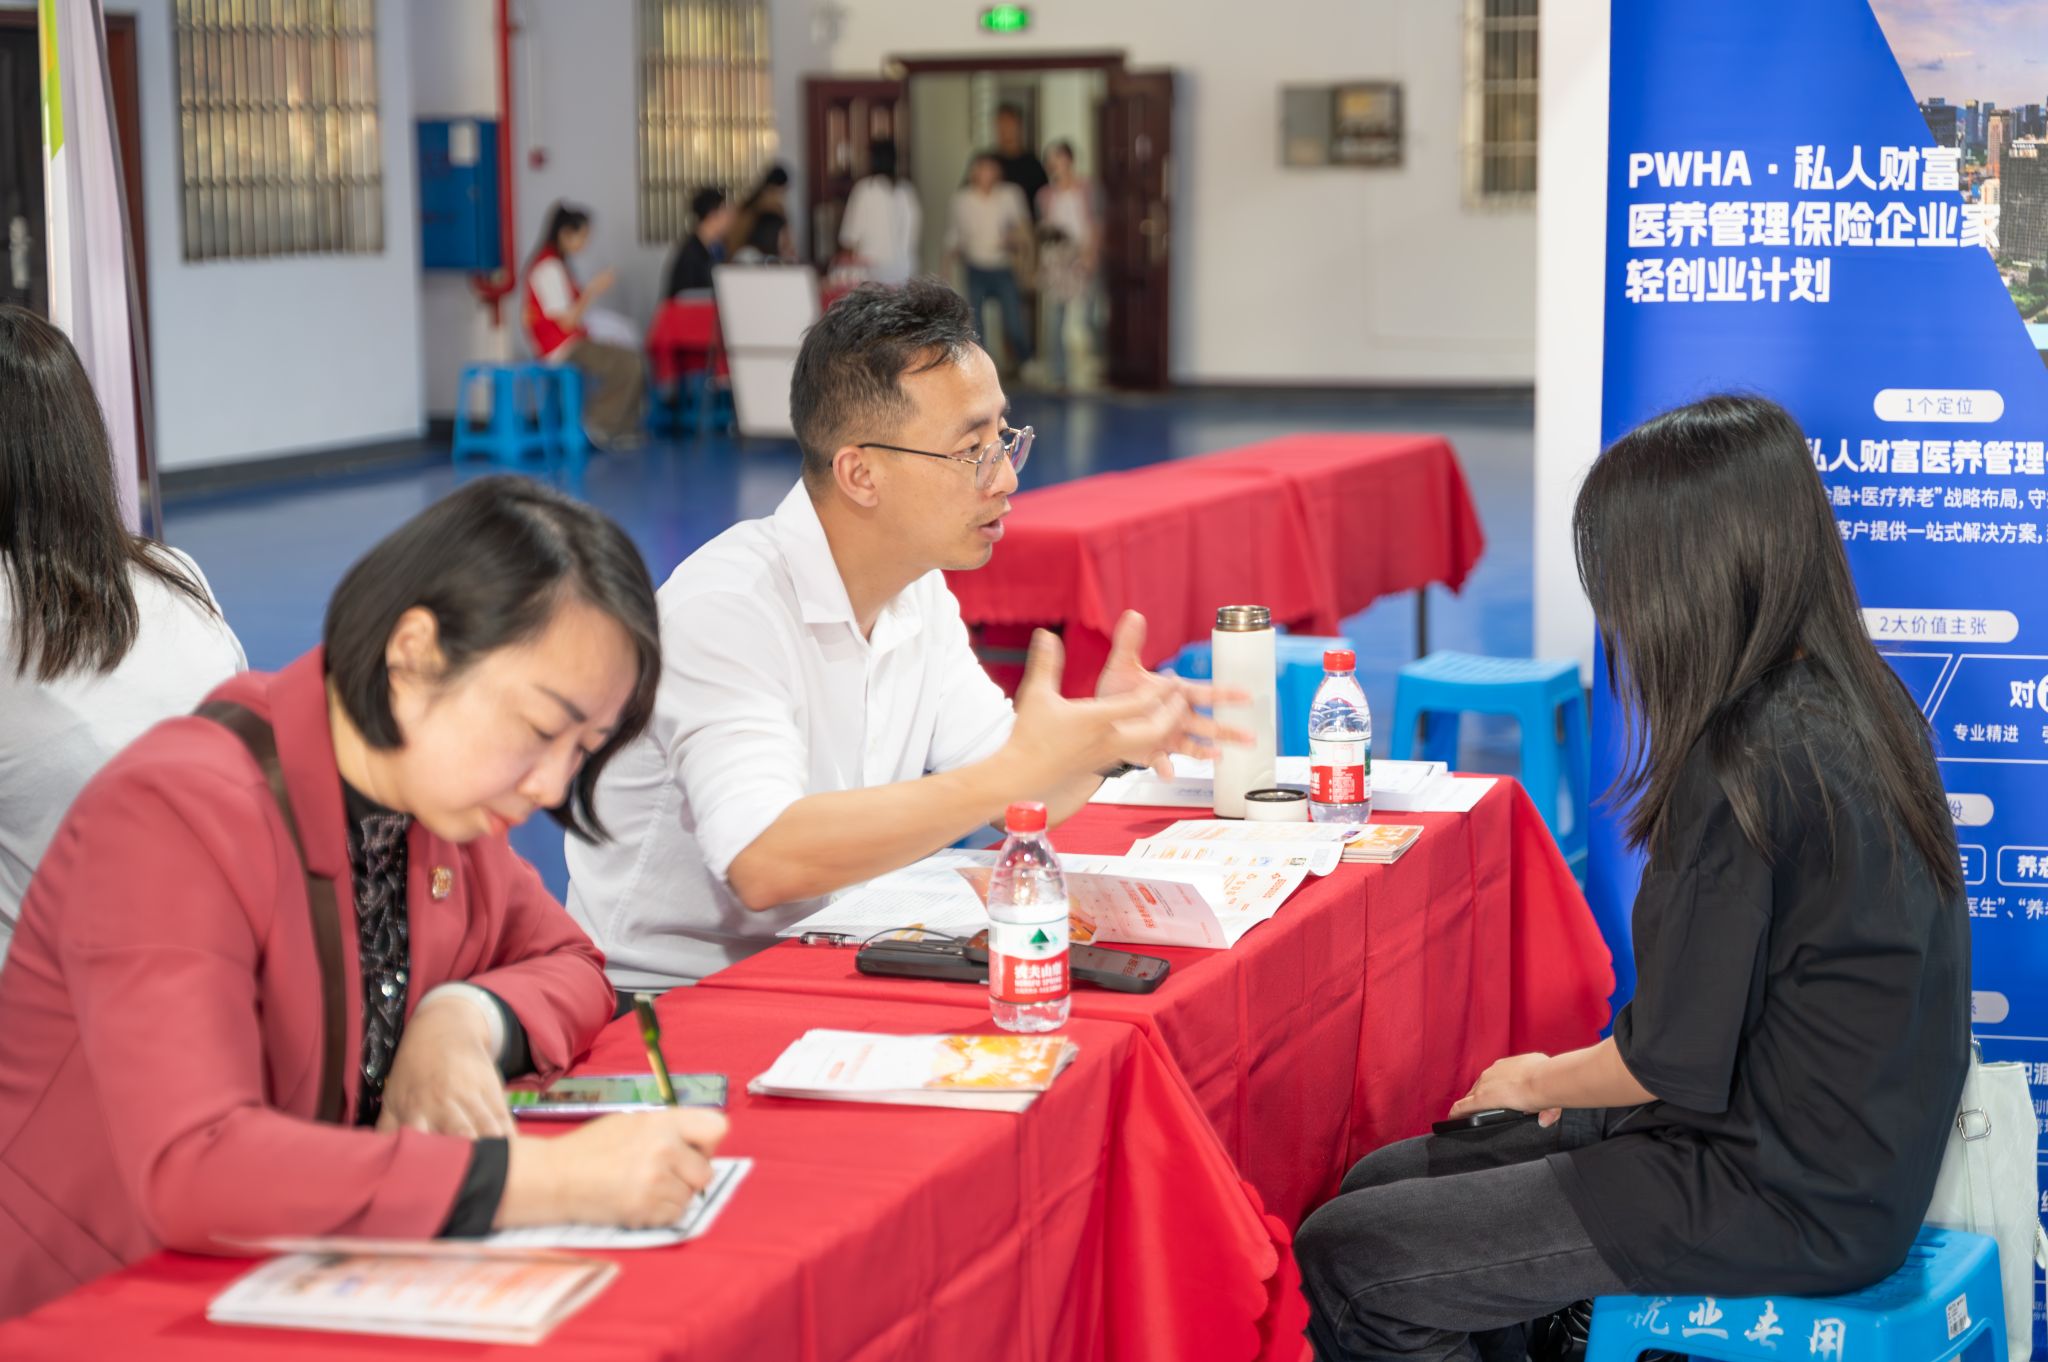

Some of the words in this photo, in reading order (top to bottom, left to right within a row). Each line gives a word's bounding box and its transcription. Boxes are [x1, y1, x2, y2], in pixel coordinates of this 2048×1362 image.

[1628, 150, 1752, 188] PWHA
[1793, 145, 1962, 192] 私人财富
[1628, 201, 2001, 249] 医养管理保险企业家
[1625, 256, 1831, 303] 轻创业计划
[1905, 396, 1974, 416] 1个定位
[1805, 438, 2048, 475] 私人财富医养管理
[1837, 520, 2048, 544] 客户提供一站式解决方案，
[1879, 615, 1988, 636] 2大价值主张
[1953, 723, 2019, 743] 专业精进
